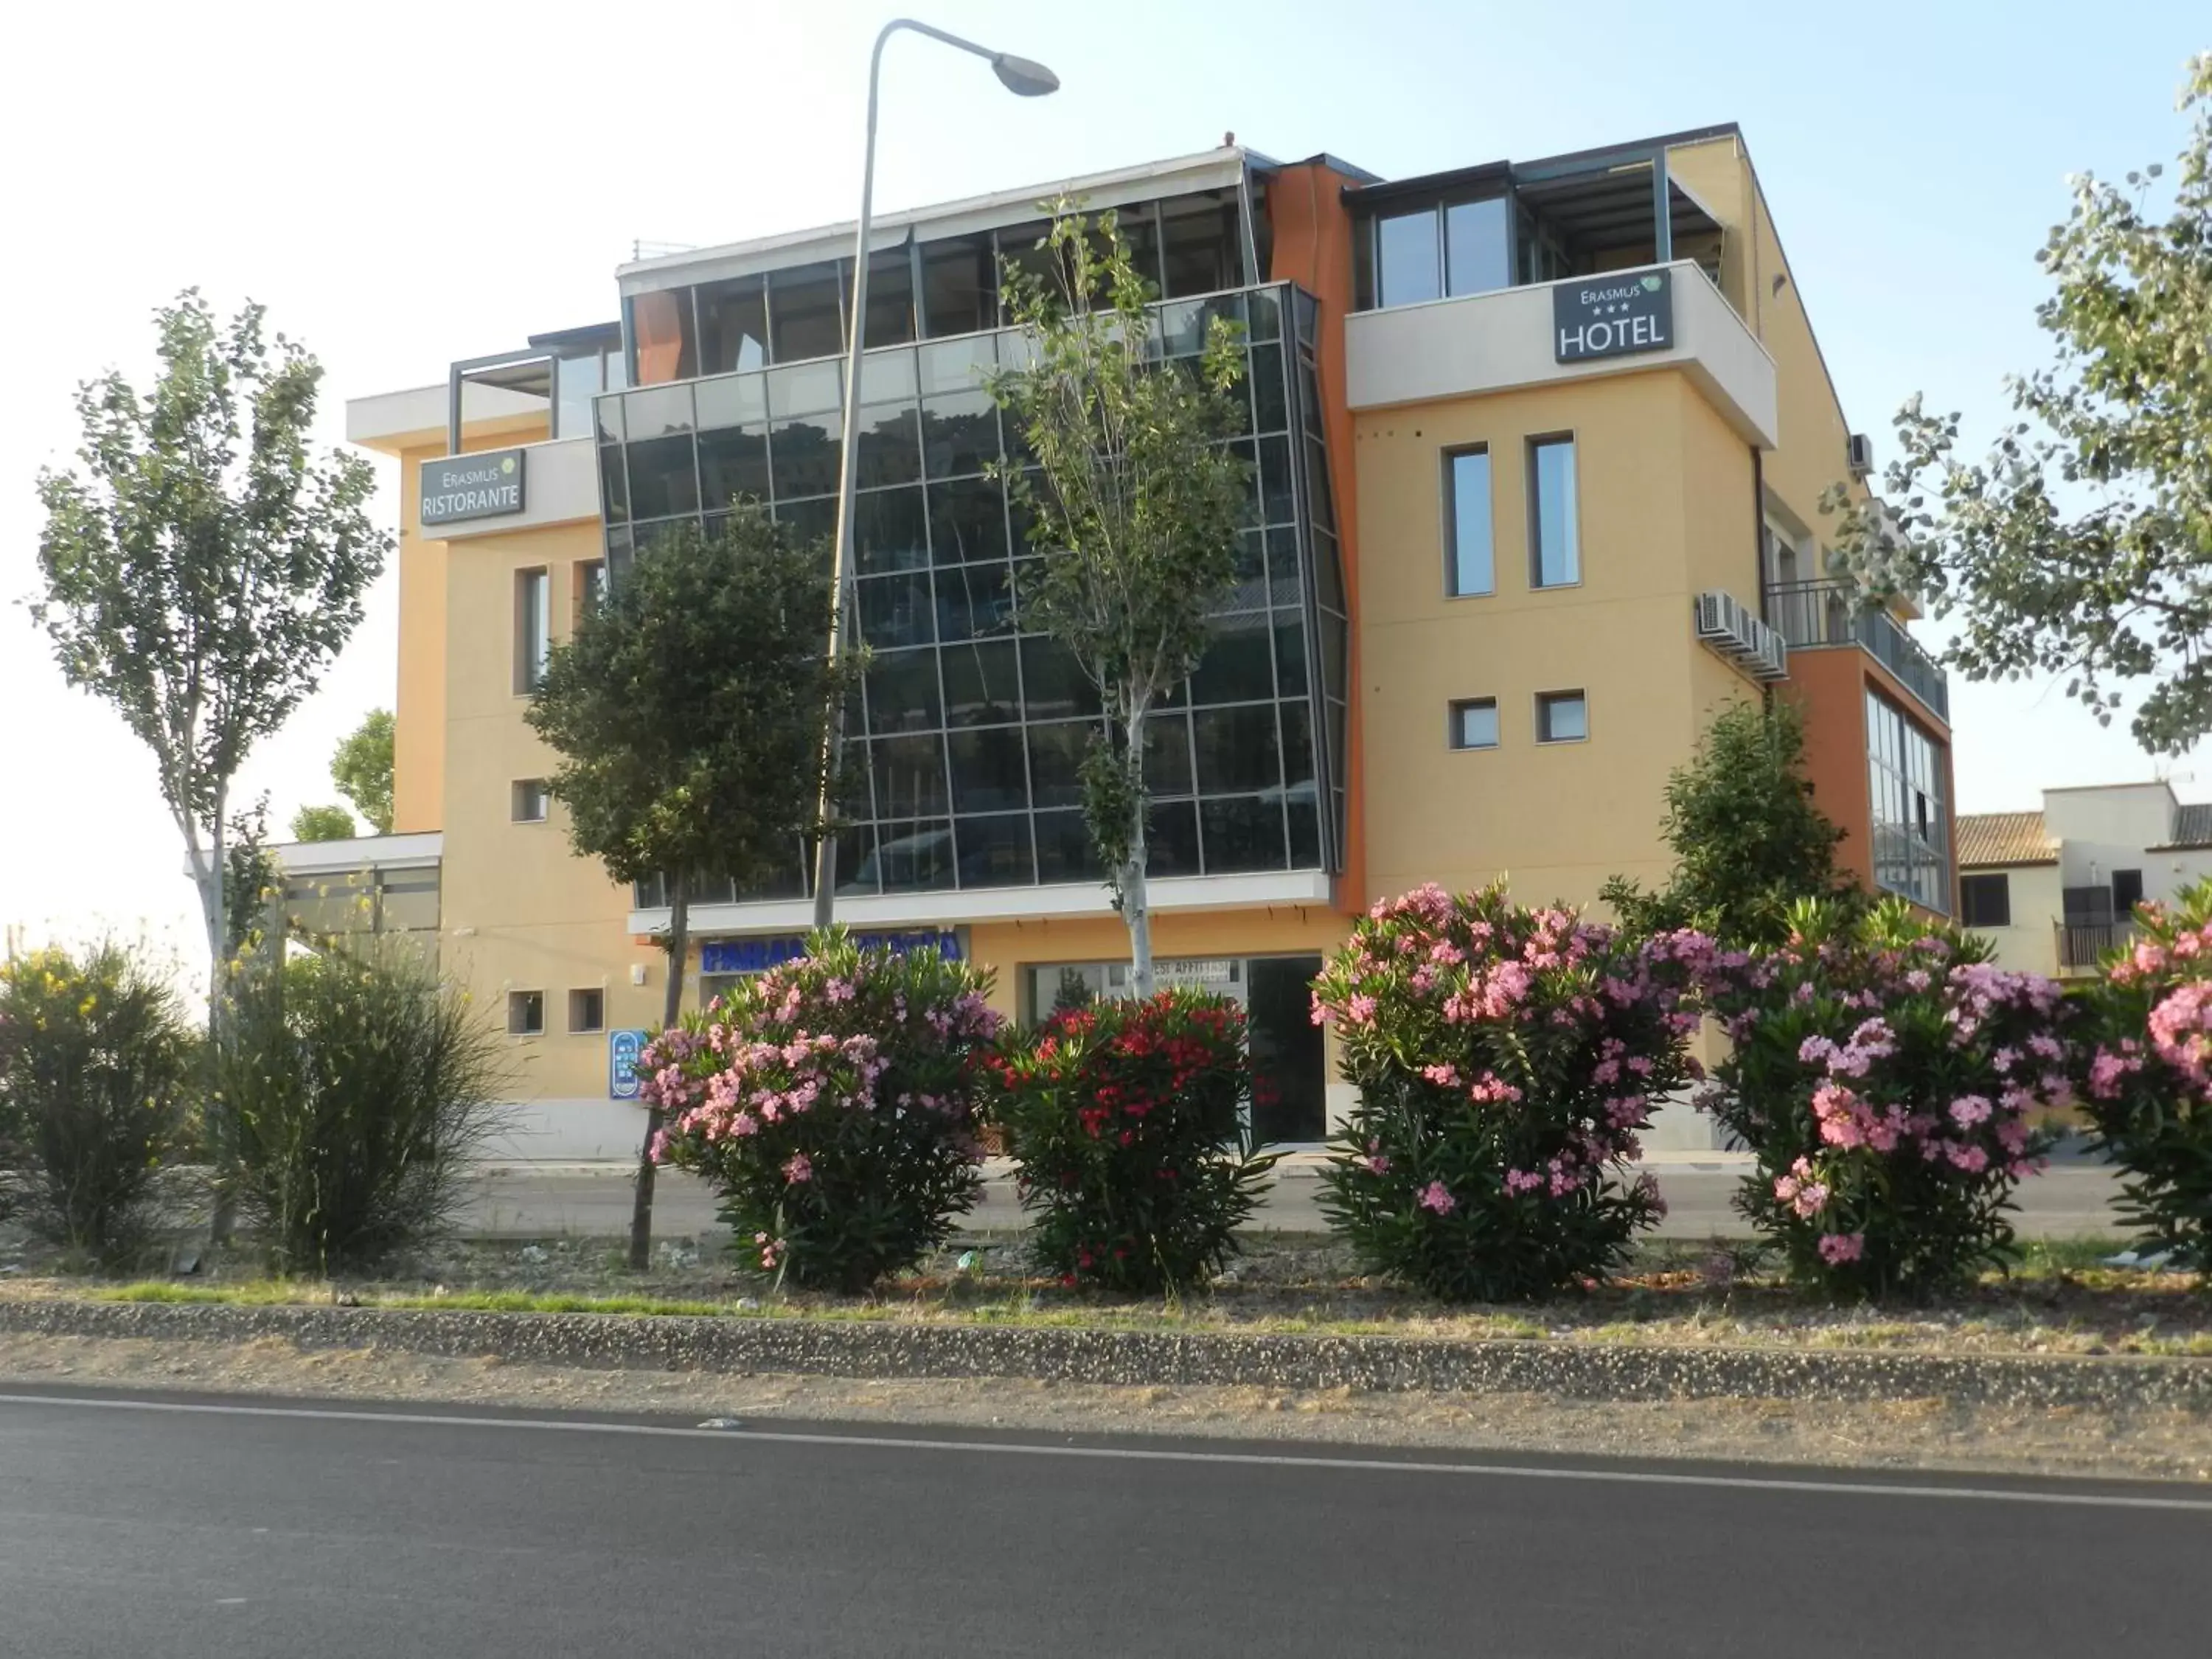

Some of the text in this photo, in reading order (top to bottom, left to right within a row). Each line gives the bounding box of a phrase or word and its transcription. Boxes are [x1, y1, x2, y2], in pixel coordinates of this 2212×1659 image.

[1580, 285, 1641, 305] ERASMUS
[1560, 315, 1664, 356] HOTEL
[422, 484, 518, 516] RISTORANTE
